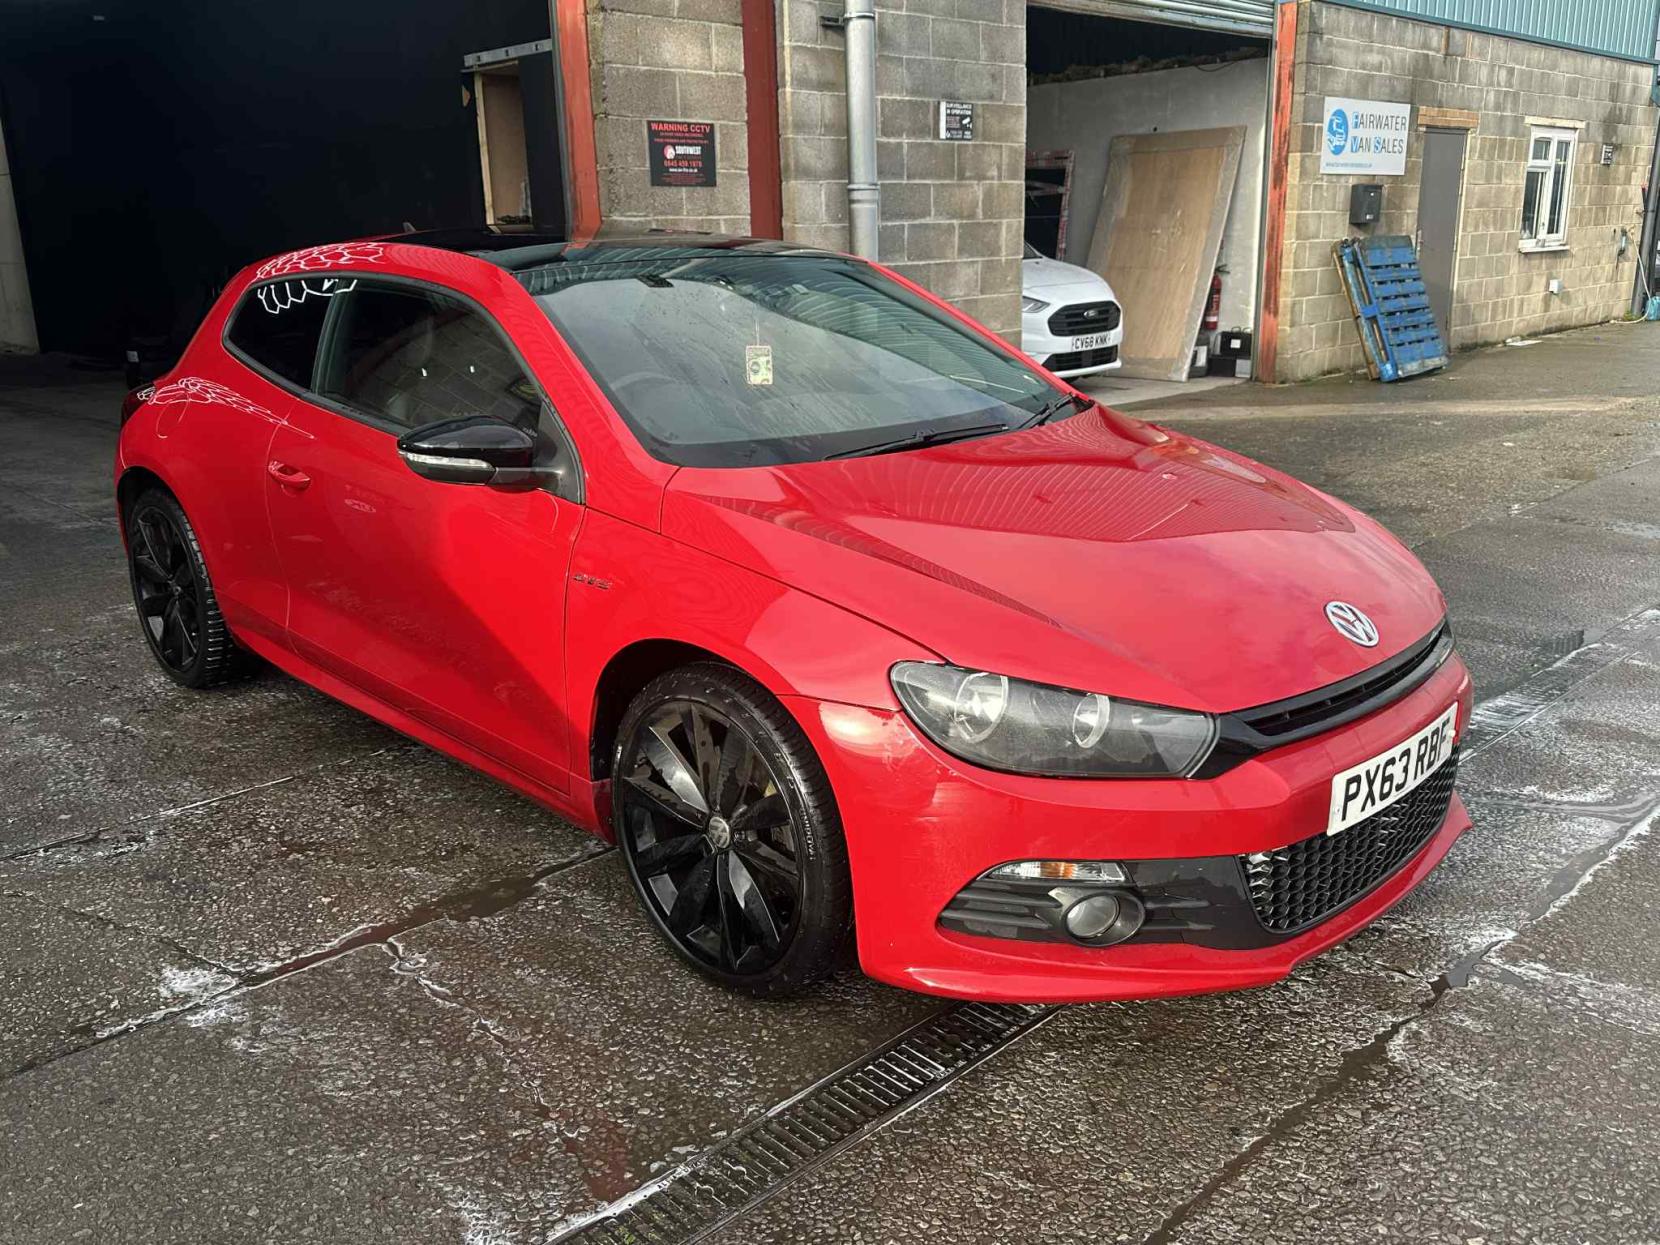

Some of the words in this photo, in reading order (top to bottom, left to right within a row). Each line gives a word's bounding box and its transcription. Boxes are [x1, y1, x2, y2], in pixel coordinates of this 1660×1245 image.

[651, 122, 689, 132] WARNING
[690, 124, 711, 133] CCTV
[1352, 112, 1407, 131] FAIRWATER
[1350, 136, 1371, 153] VAN
[1373, 136, 1404, 154] SALES
[1074, 336, 1095, 349] CV68
[1341, 747, 1411, 822] PX63
[1413, 716, 1451, 781] RBF
